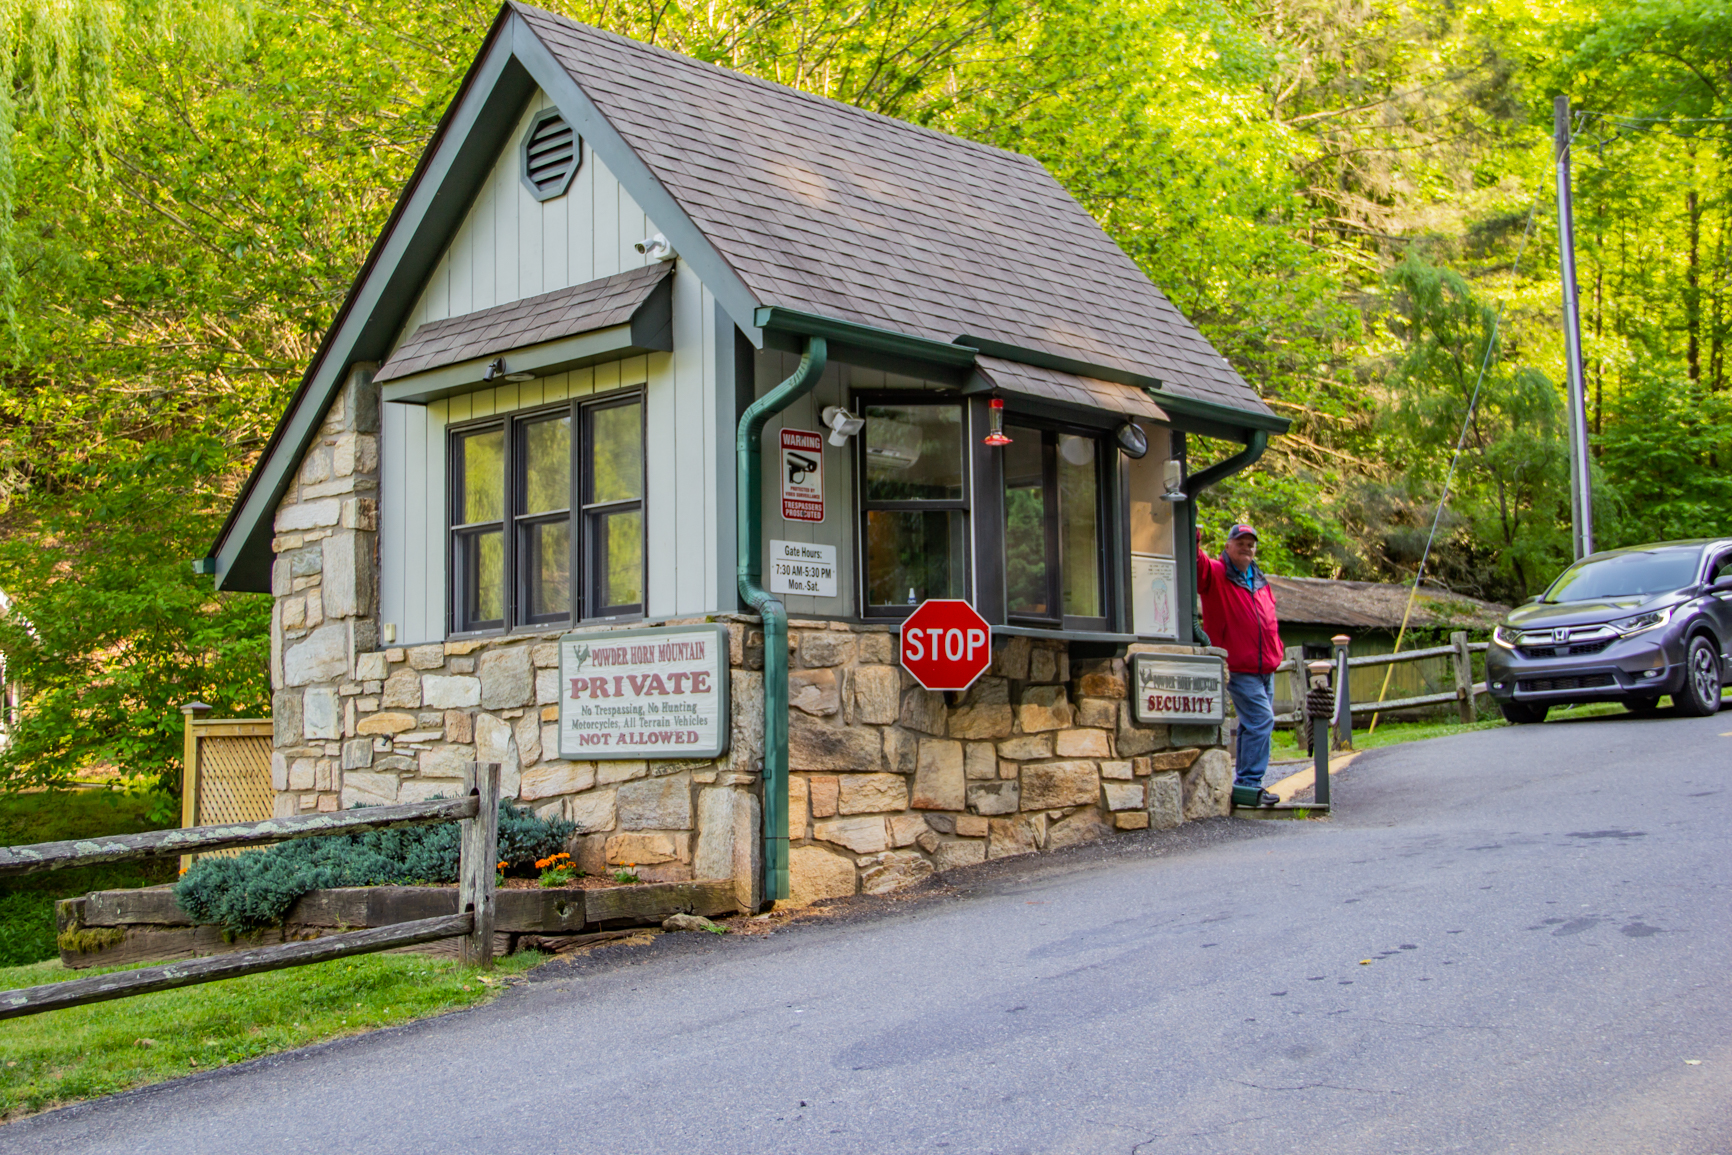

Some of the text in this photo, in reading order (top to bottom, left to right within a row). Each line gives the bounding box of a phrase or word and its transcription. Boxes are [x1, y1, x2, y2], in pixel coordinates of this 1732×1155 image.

[782, 433, 820, 449] WARNING
[784, 501, 822, 511] TRESPASSERS
[784, 545, 822, 559] Gate Hours:
[776, 563, 791, 575] 7:30
[821, 567, 831, 579] PM
[905, 627, 986, 662] STOP
[591, 641, 705, 667] POWDER HORN MOUNTAIN
[569, 670, 712, 699] PRIVATE
[581, 701, 698, 717] No Trespassing, No Hunting
[1147, 694, 1214, 713] SECURITY
[571, 714, 708, 731] Motorcycles, All Terrain Vehicles
[579, 730, 699, 746] NOT ALLOWED
